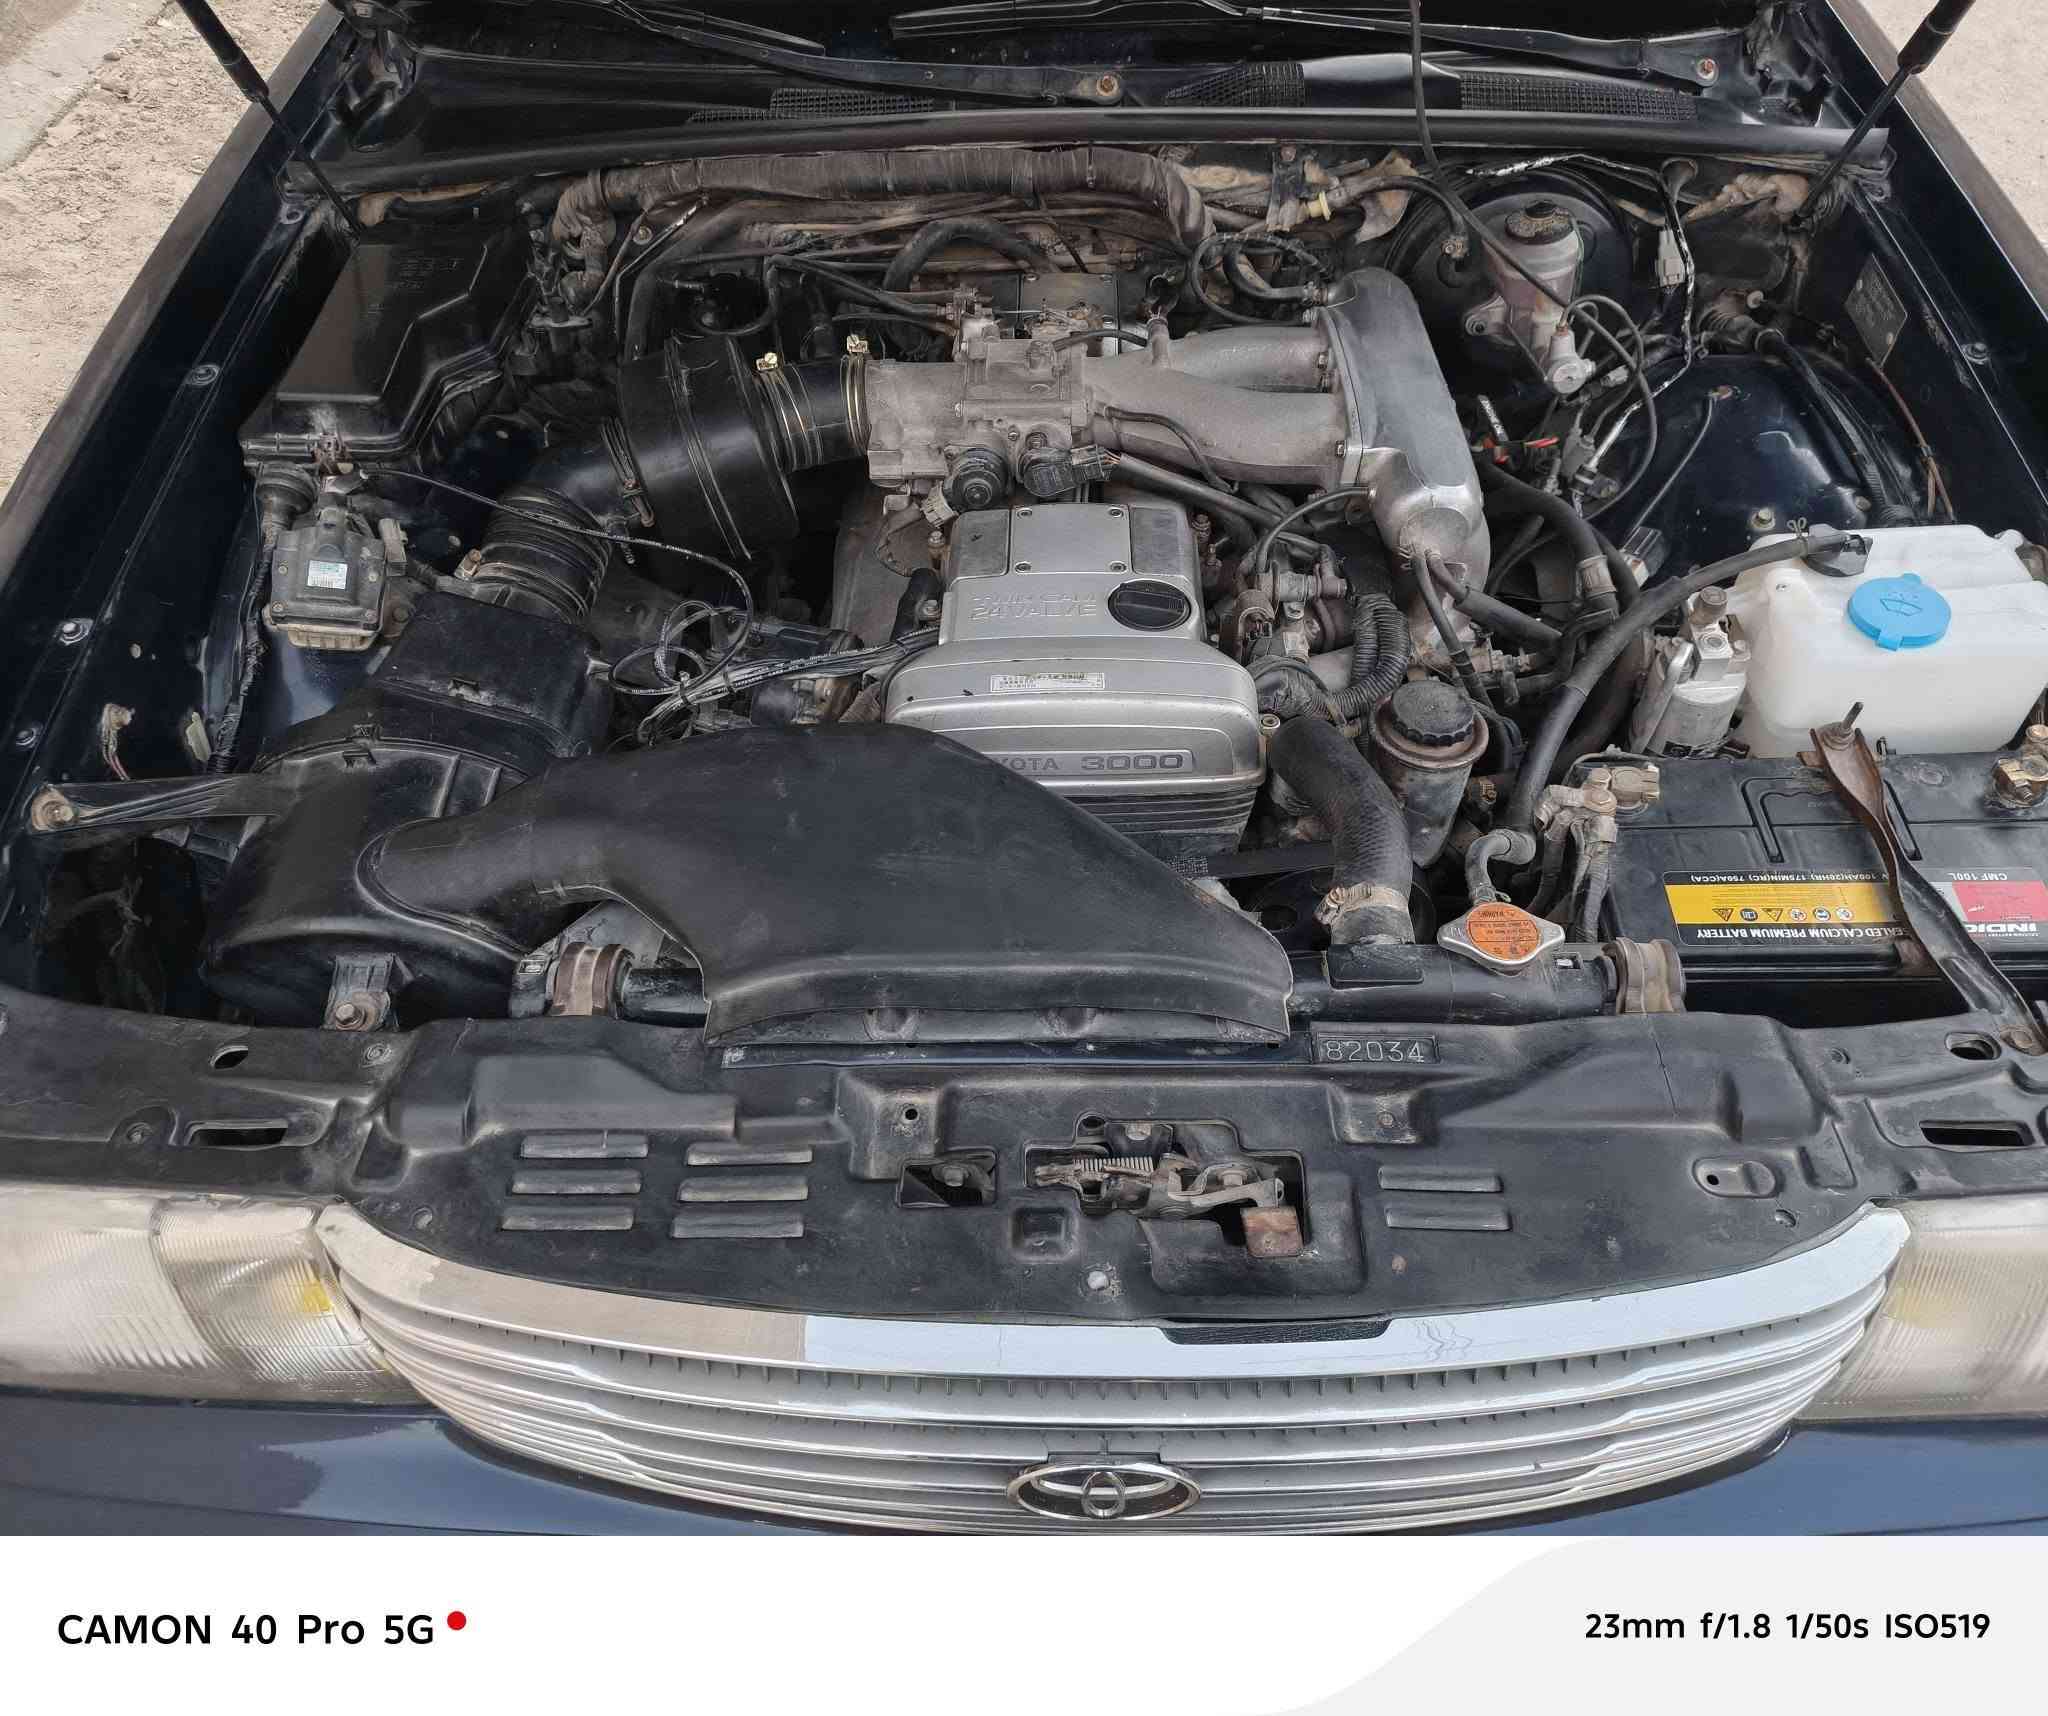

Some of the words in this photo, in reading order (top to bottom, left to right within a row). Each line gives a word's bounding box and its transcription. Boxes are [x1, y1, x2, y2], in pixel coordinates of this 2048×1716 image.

[994, 757, 1060, 771] YOTA
[1080, 754, 1184, 771] 3000
[1948, 872, 1980, 881] 100L
[1980, 872, 2008, 881] CMF
[1696, 928, 1748, 939] BATTERY
[1750, 928, 1806, 939] PREMIUM
[1808, 928, 1864, 939] CALCIUM
[1326, 1040, 1425, 1063] 82034
